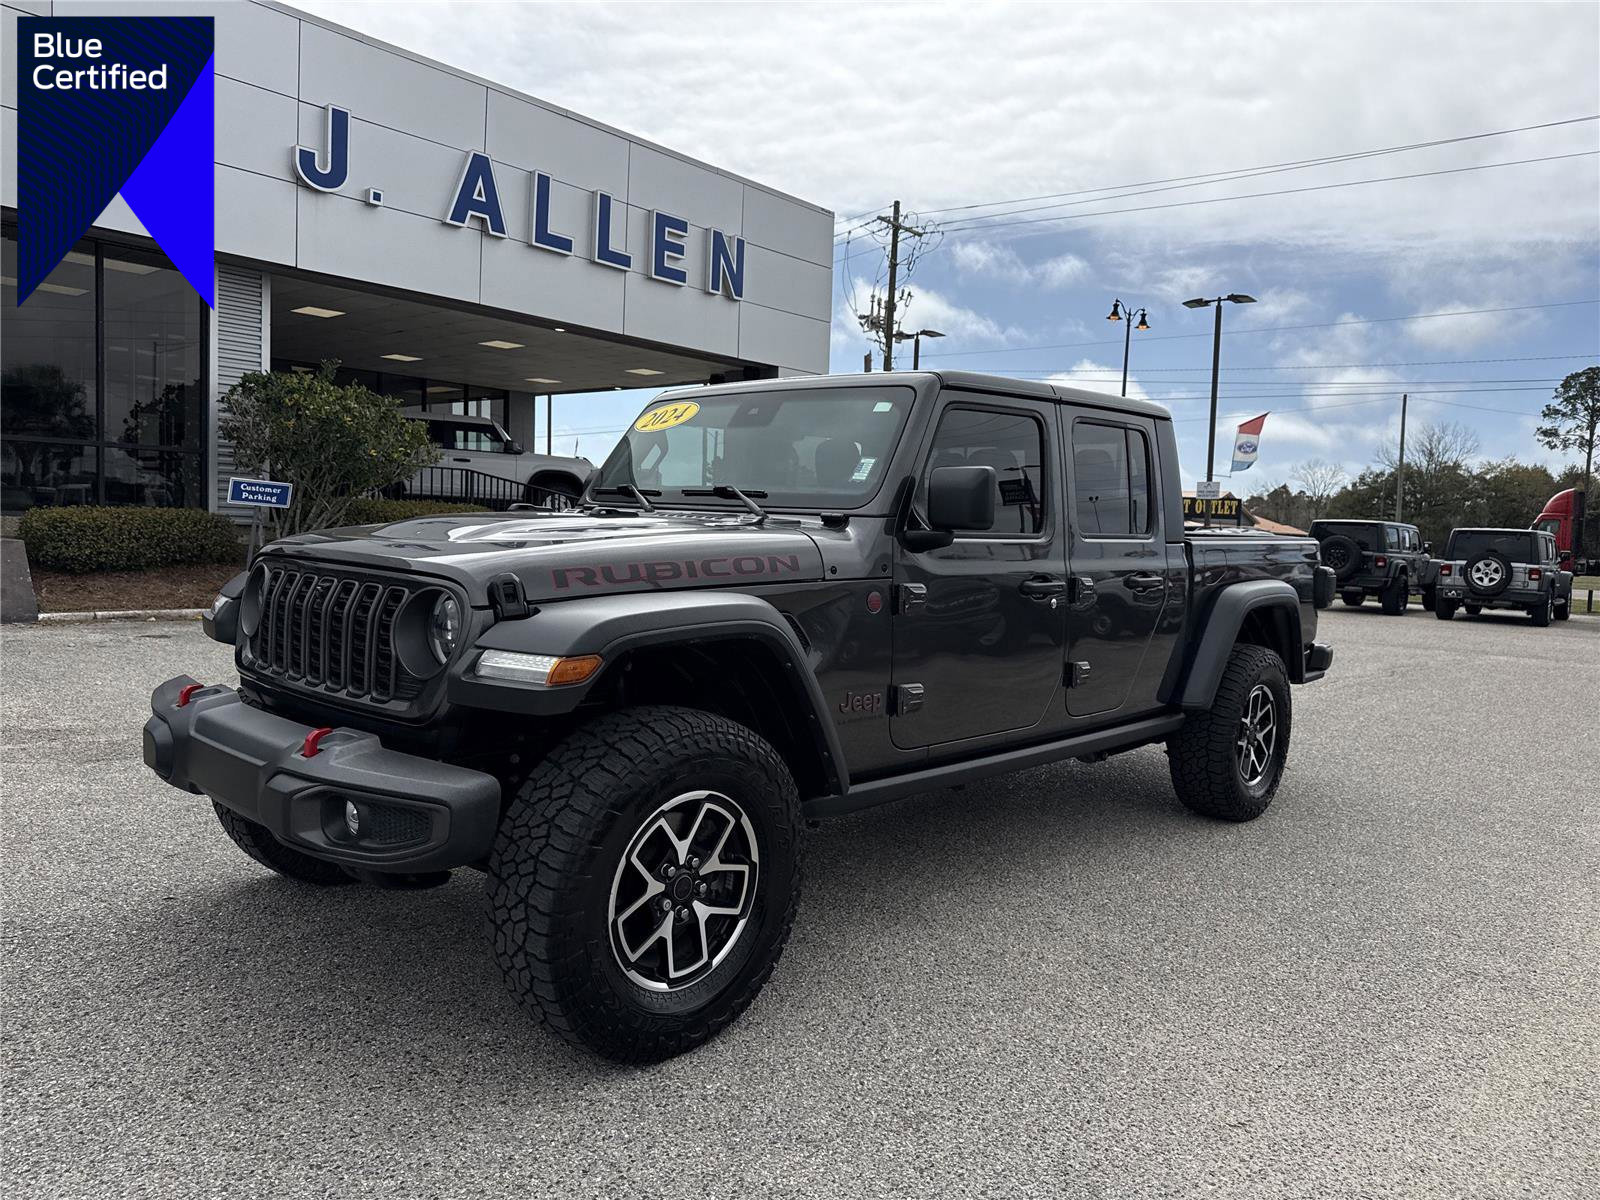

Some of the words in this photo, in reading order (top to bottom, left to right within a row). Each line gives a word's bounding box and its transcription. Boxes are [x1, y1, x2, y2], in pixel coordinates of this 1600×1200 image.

[291, 104, 385, 206] J.
[443, 149, 748, 301] ALLEN
[640, 404, 692, 428] 2024
[240, 483, 282, 494] Customer
[242, 491, 277, 503] Parking
[551, 554, 800, 588] RUBICON
[839, 691, 882, 713] Jeep
